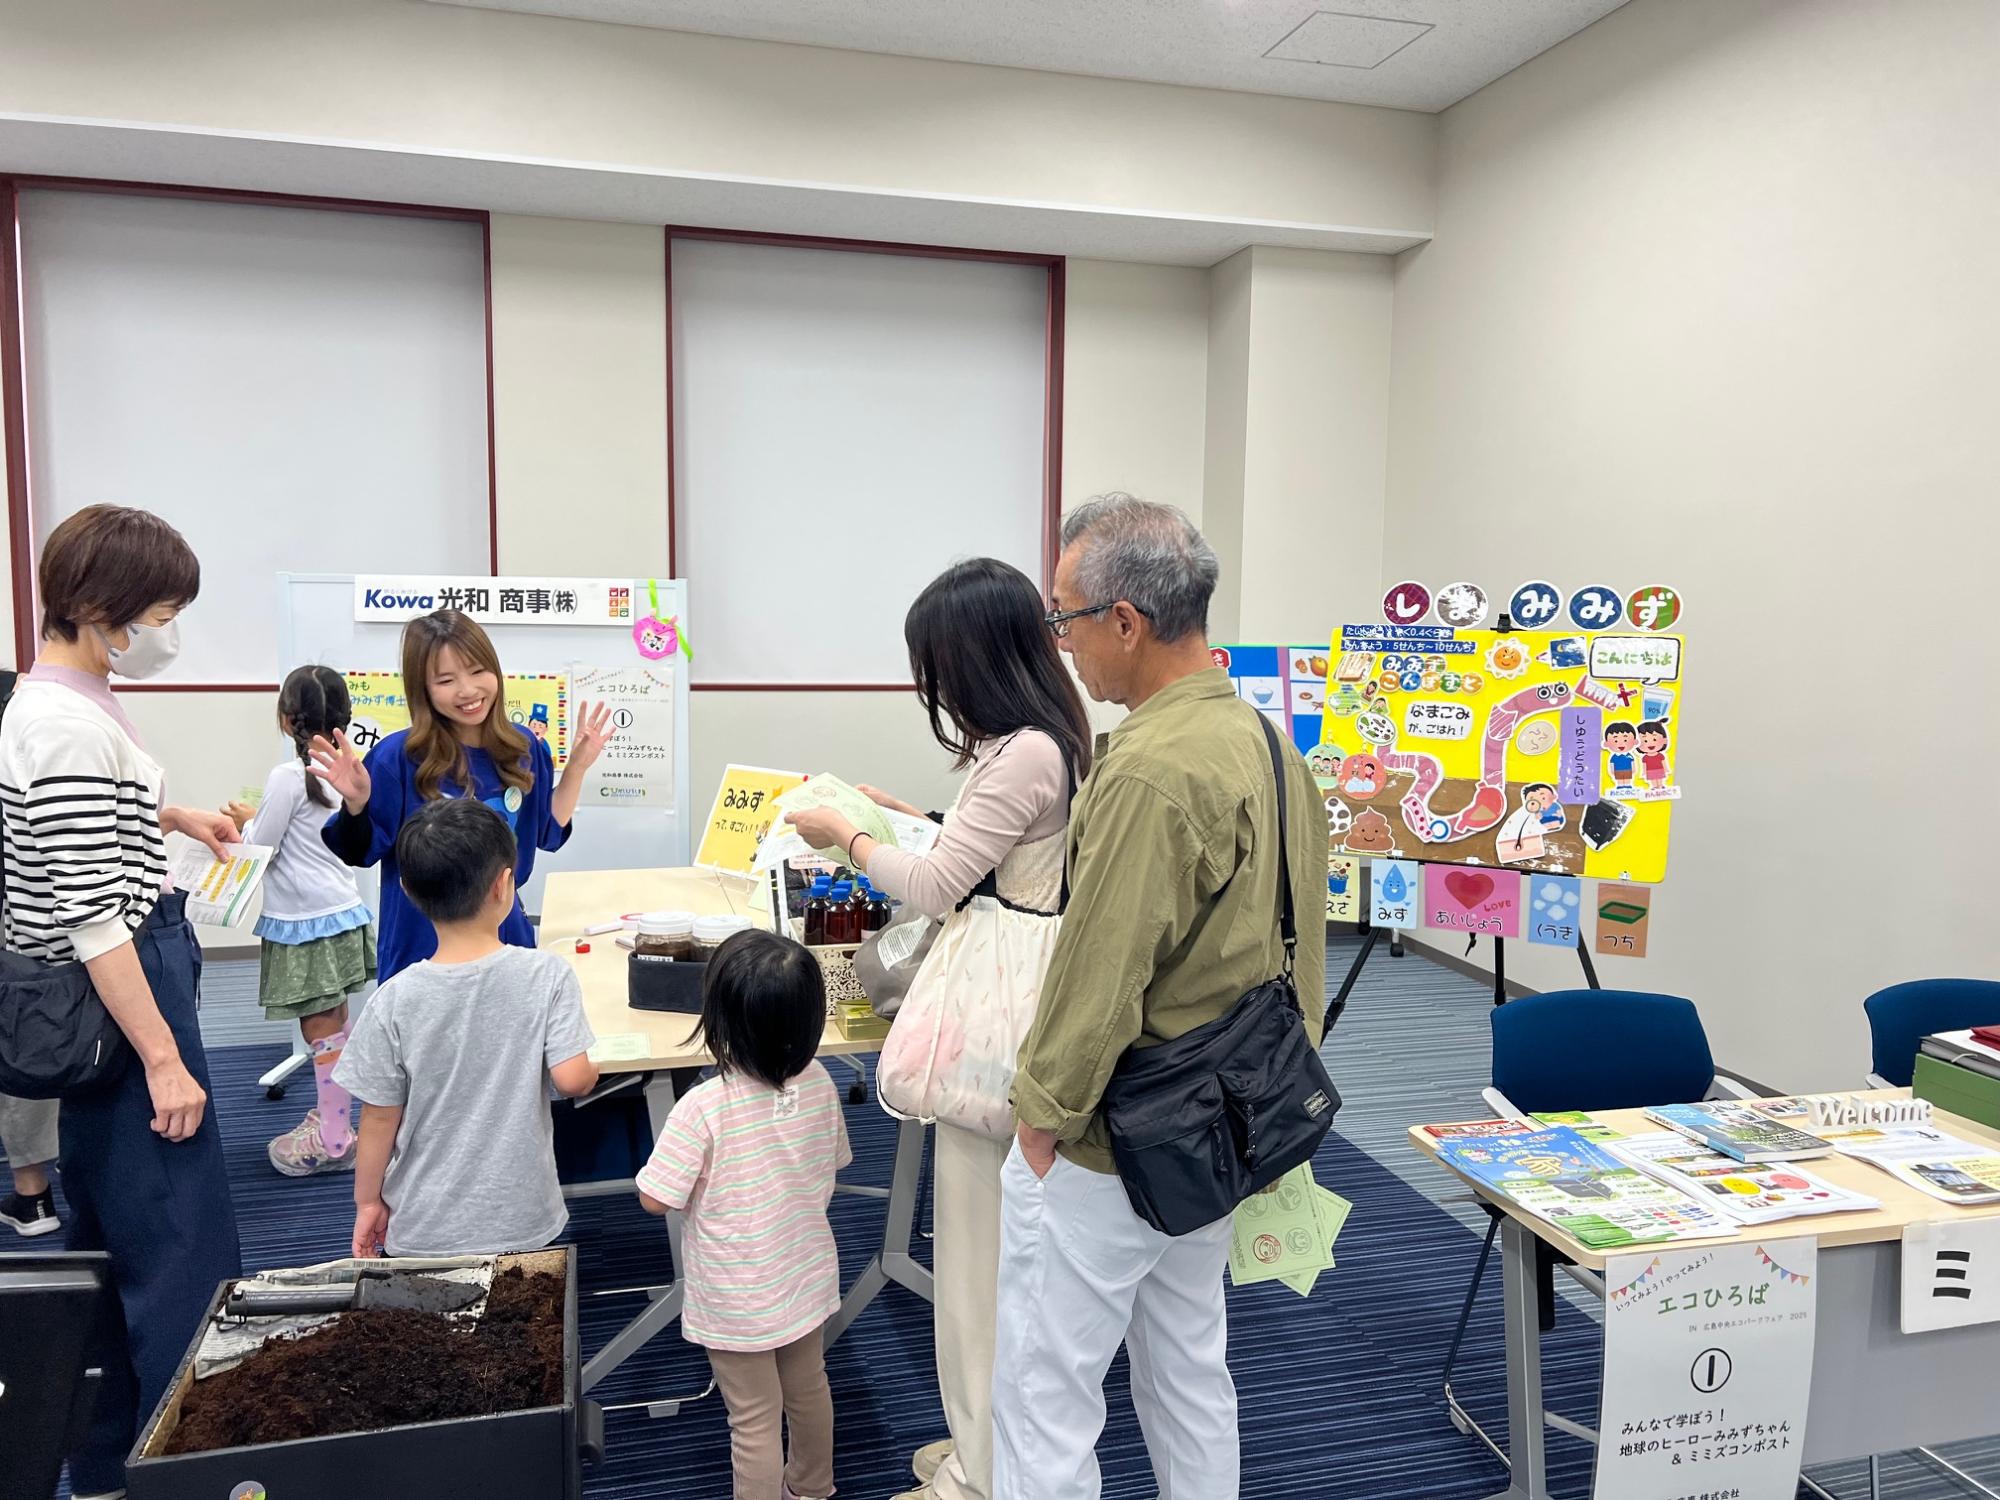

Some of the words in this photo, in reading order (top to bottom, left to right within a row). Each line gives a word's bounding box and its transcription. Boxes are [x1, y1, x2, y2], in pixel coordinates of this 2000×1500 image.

[364, 589, 433, 609] Kowa
[438, 587, 489, 612] 光和
[597, 683, 650, 695] エコひろば
[1410, 704, 1470, 720] なまごみ
[723, 788, 765, 813] みみず
[1378, 907, 1408, 922] みず
[1483, 899, 1512, 913] LOVE
[1603, 934, 1636, 950] つち
[1811, 1096, 1934, 1127] Welcome
[1657, 1282, 1770, 1315] エコひろば
[1619, 1420, 1791, 1457] 地球のヒーローみみずちゃん
[1671, 1453, 1682, 1465] &
[1690, 1436, 1791, 1462] ミミズコンポスト
